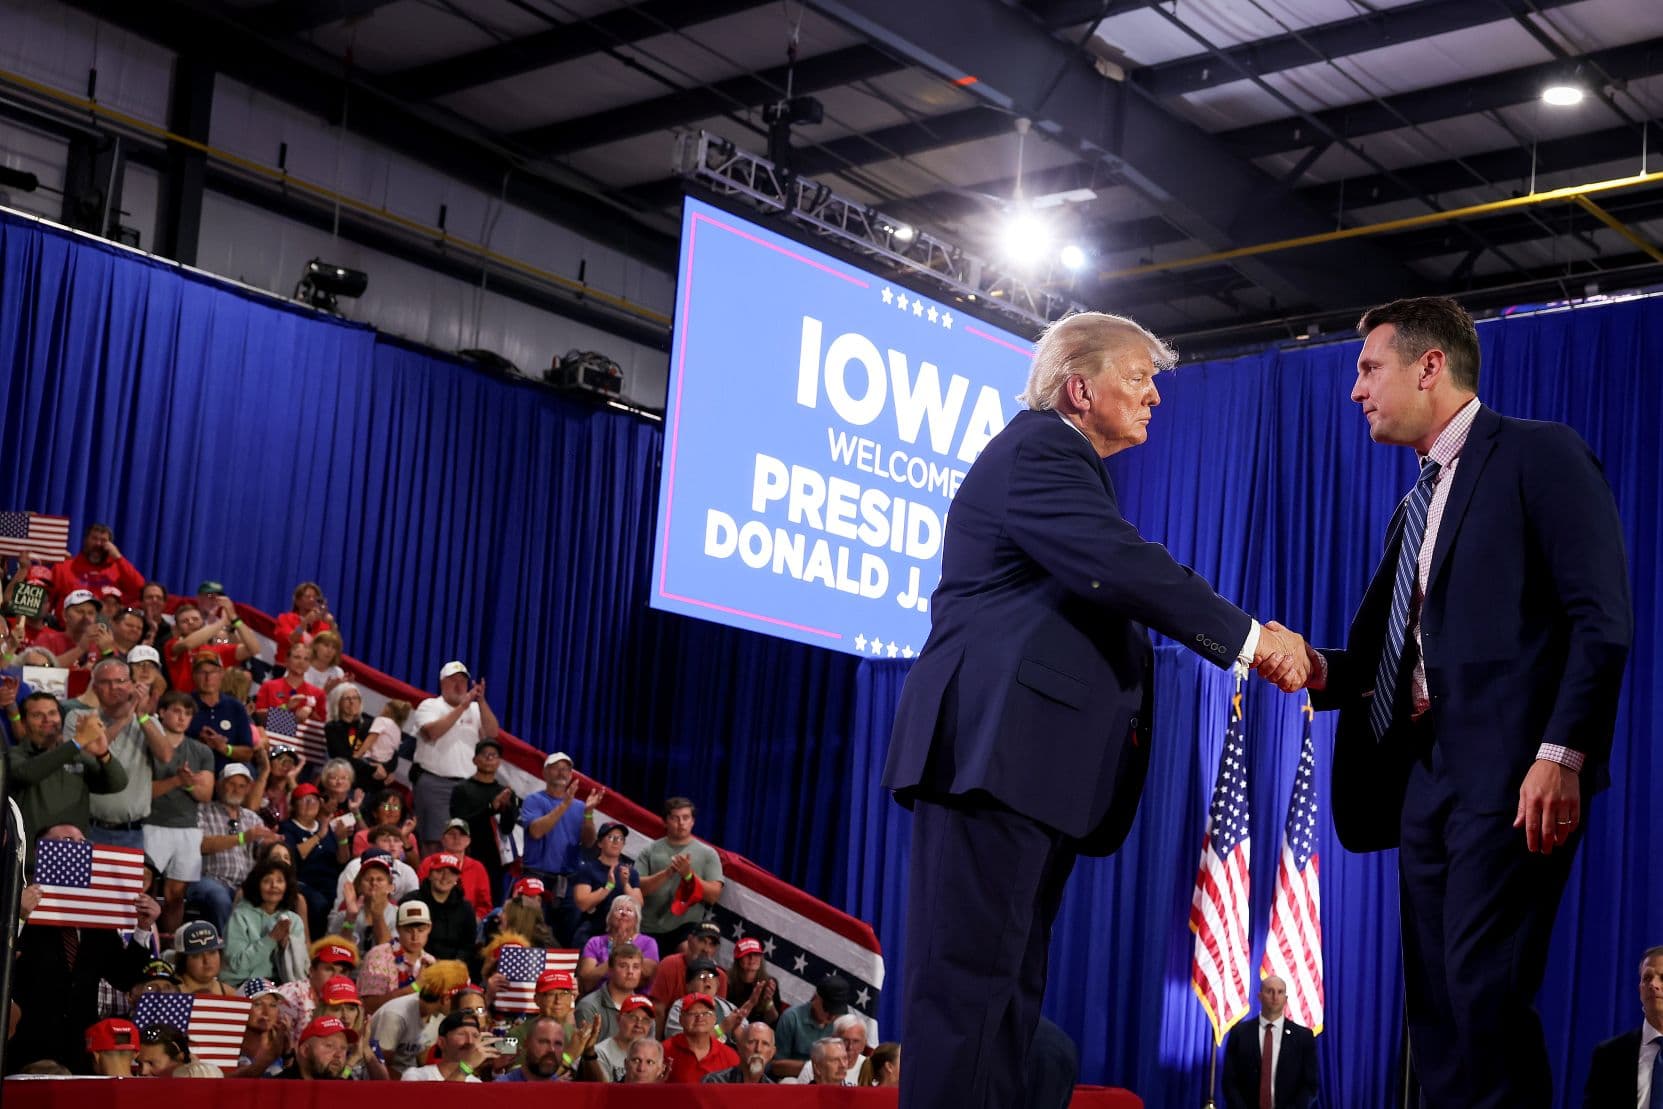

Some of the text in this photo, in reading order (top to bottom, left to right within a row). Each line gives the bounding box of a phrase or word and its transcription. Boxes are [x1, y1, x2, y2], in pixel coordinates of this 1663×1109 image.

[797, 315, 1006, 464] IOWA
[751, 453, 949, 560] PRESID
[14, 593, 42, 610] LAHN
[17, 582, 44, 597] ZACH
[704, 508, 929, 613] DONALD J.
